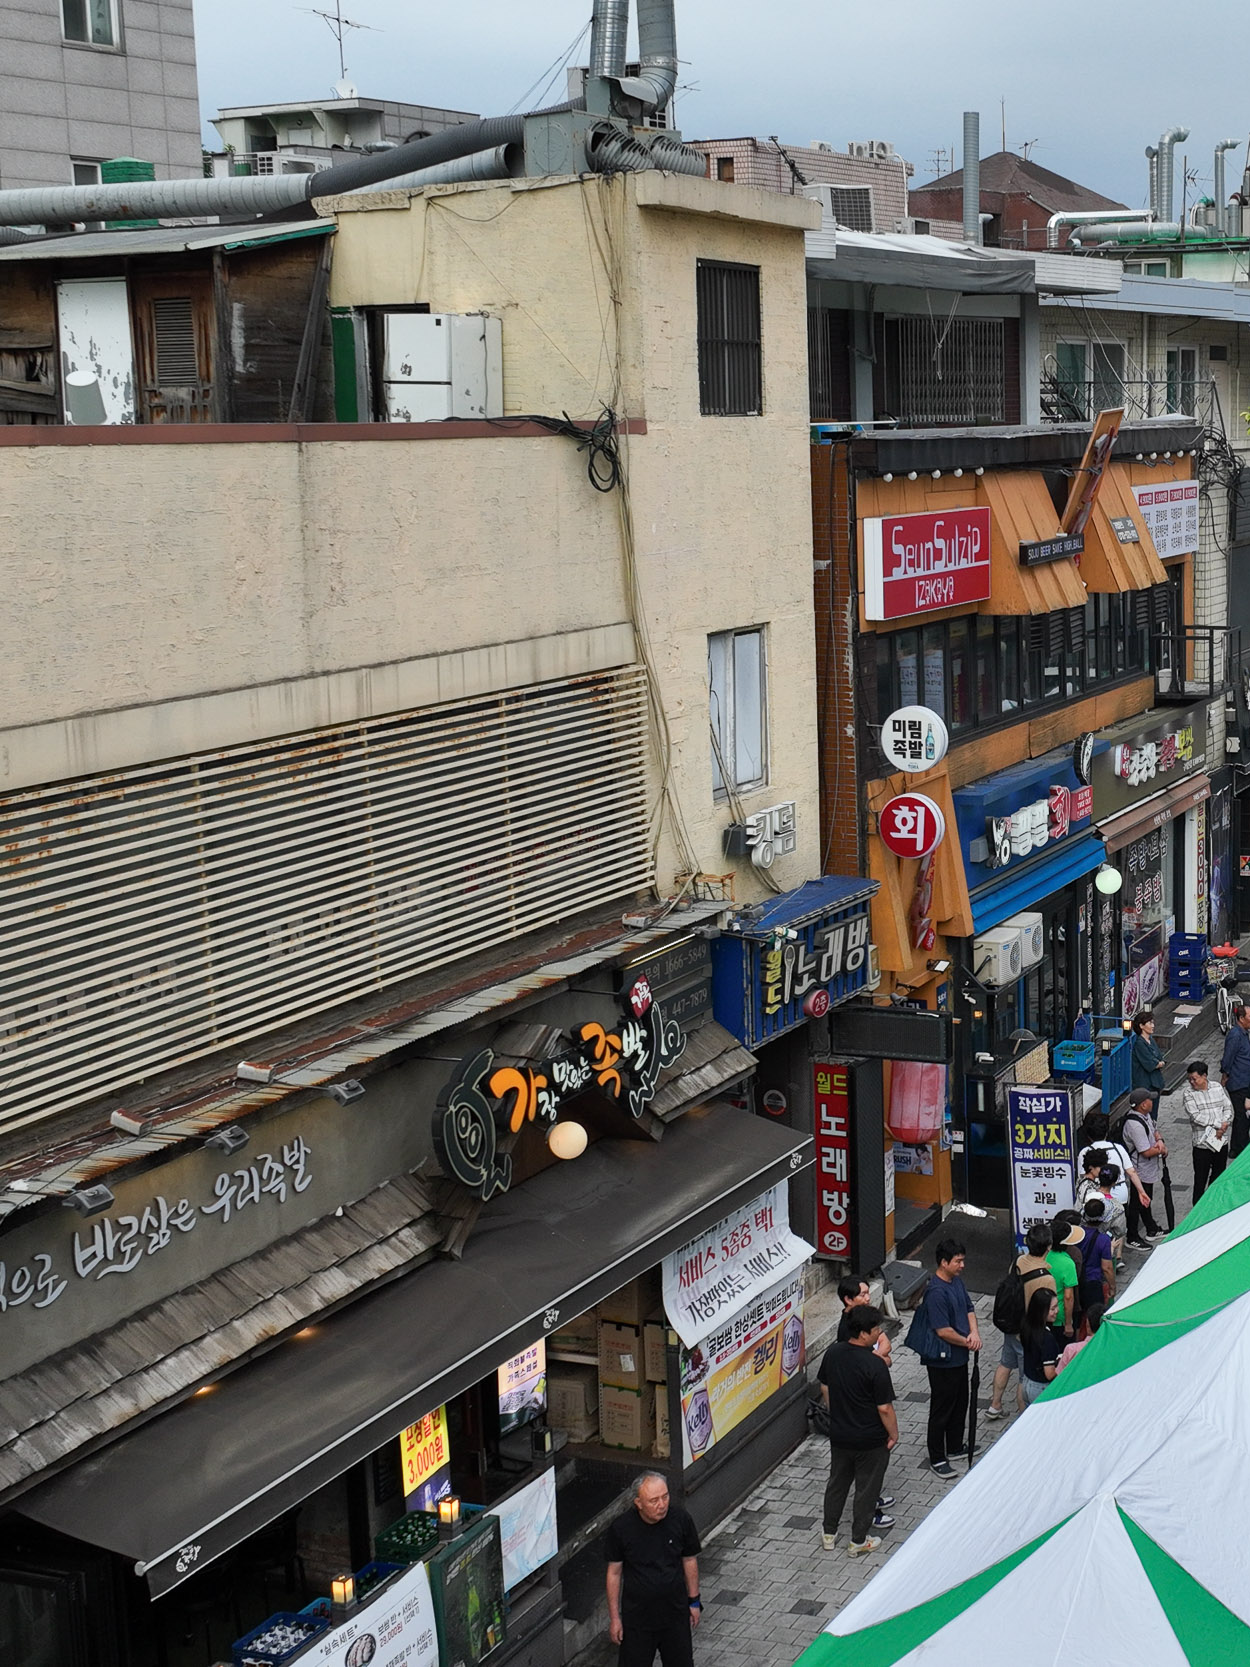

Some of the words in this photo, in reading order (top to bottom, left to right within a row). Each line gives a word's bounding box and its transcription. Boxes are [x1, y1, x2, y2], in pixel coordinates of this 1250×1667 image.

[1040, 546, 1051, 558] BEER
[915, 576, 954, 609] IZAKAYA
[892, 719, 923, 739] 미림
[893, 739, 923, 760] 족발
[889, 805, 925, 851] 회
[665, 944, 706, 975] 1666-5849
[794, 917, 869, 995] 노래방
[766, 950, 782, 1014] 월드
[815, 996, 827, 1012] 2층
[581, 1022, 649, 1098] 족발
[816, 1072, 848, 1095] 월드
[1018, 1096, 1062, 1113] 작심가
[1014, 1124, 1067, 1146] 3가지
[820, 1104, 849, 1226] 노래방
[1020, 1166, 1066, 1179] 눈꽃빙수
[74, 1196, 197, 1280] 바로삶은
[202, 1136, 312, 1222] 우리족발
[1034, 1192, 1056, 1205] 과일
[678, 1246, 717, 1292] 서비스
[722, 1219, 751, 1262] 5종중
[755, 1206, 774, 1232] 택1
[828, 1234, 844, 1247] 2F
[685, 1274, 751, 1326] 가장맛있는
[744, 1242, 791, 1280] 서비스!!
[753, 1330, 779, 1375] 켈리
[782, 1328, 801, 1354] Kelly
[687, 1402, 709, 1434] Kelly
[402, 1596, 419, 1616] 서비스
[379, 1621, 404, 1648] 29,000원
